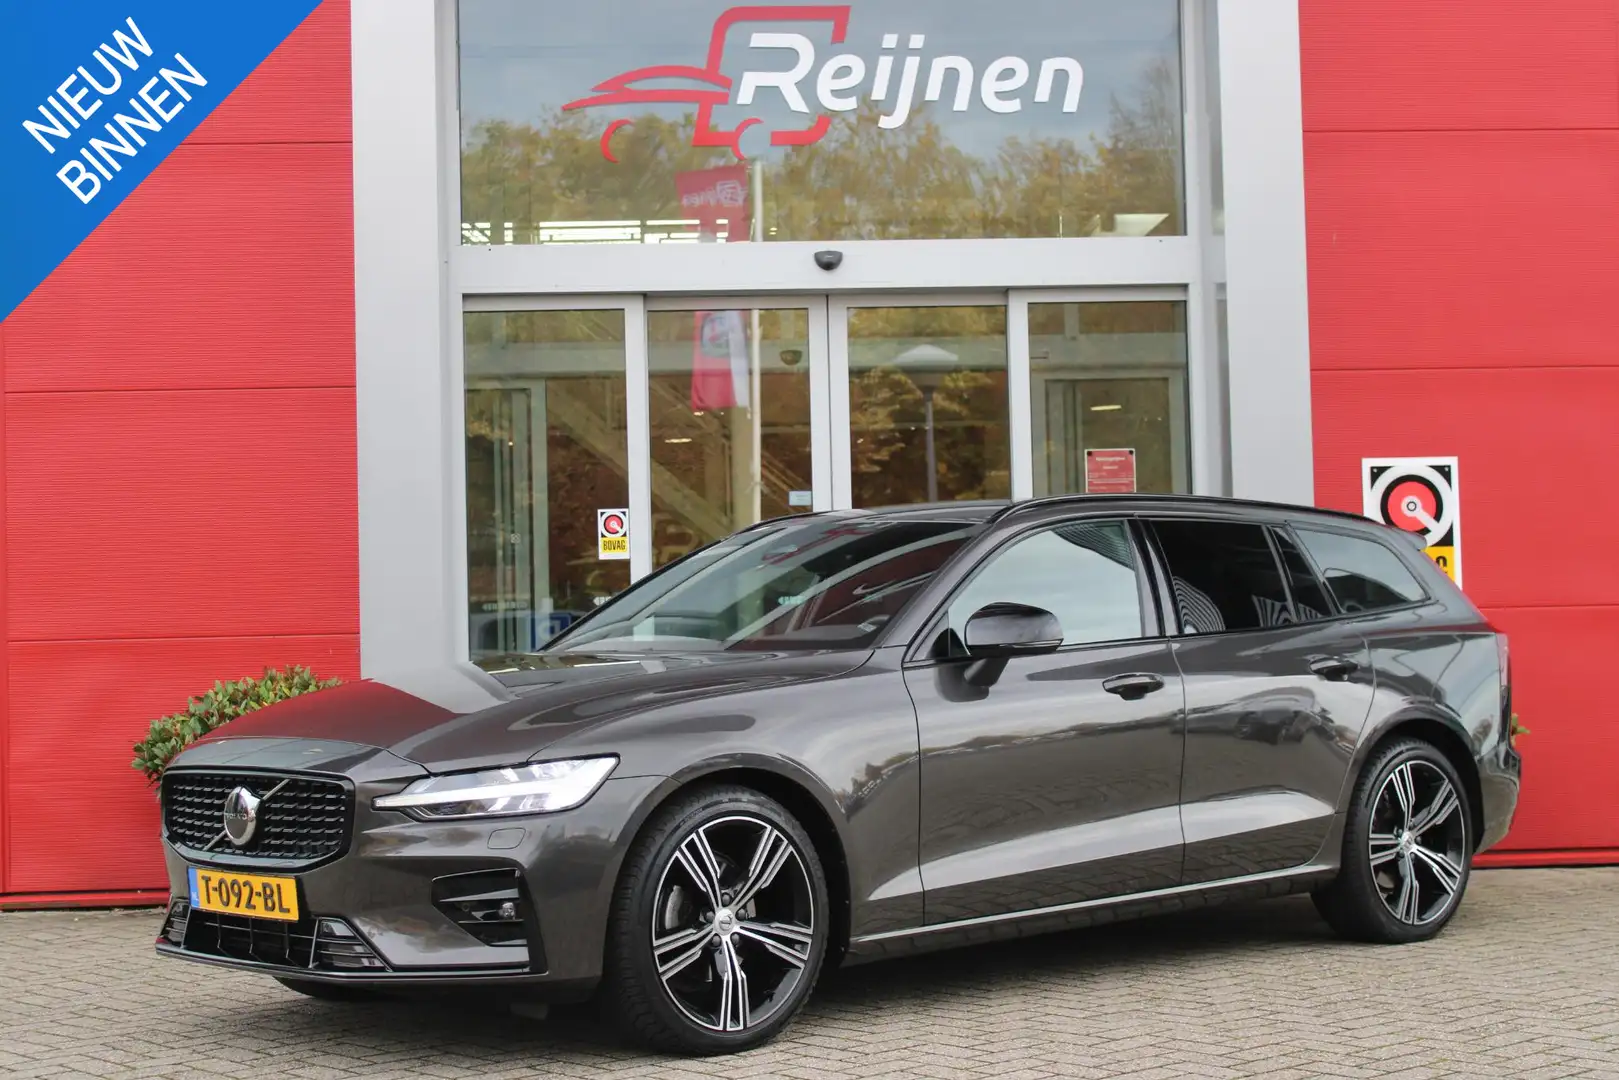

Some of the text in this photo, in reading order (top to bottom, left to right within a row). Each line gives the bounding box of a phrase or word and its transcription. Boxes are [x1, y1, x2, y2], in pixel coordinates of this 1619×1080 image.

[736, 32, 1083, 129] Reijnen
[603, 540, 626, 551] BOVAG
[201, 875, 291, 914] T-092-BL
